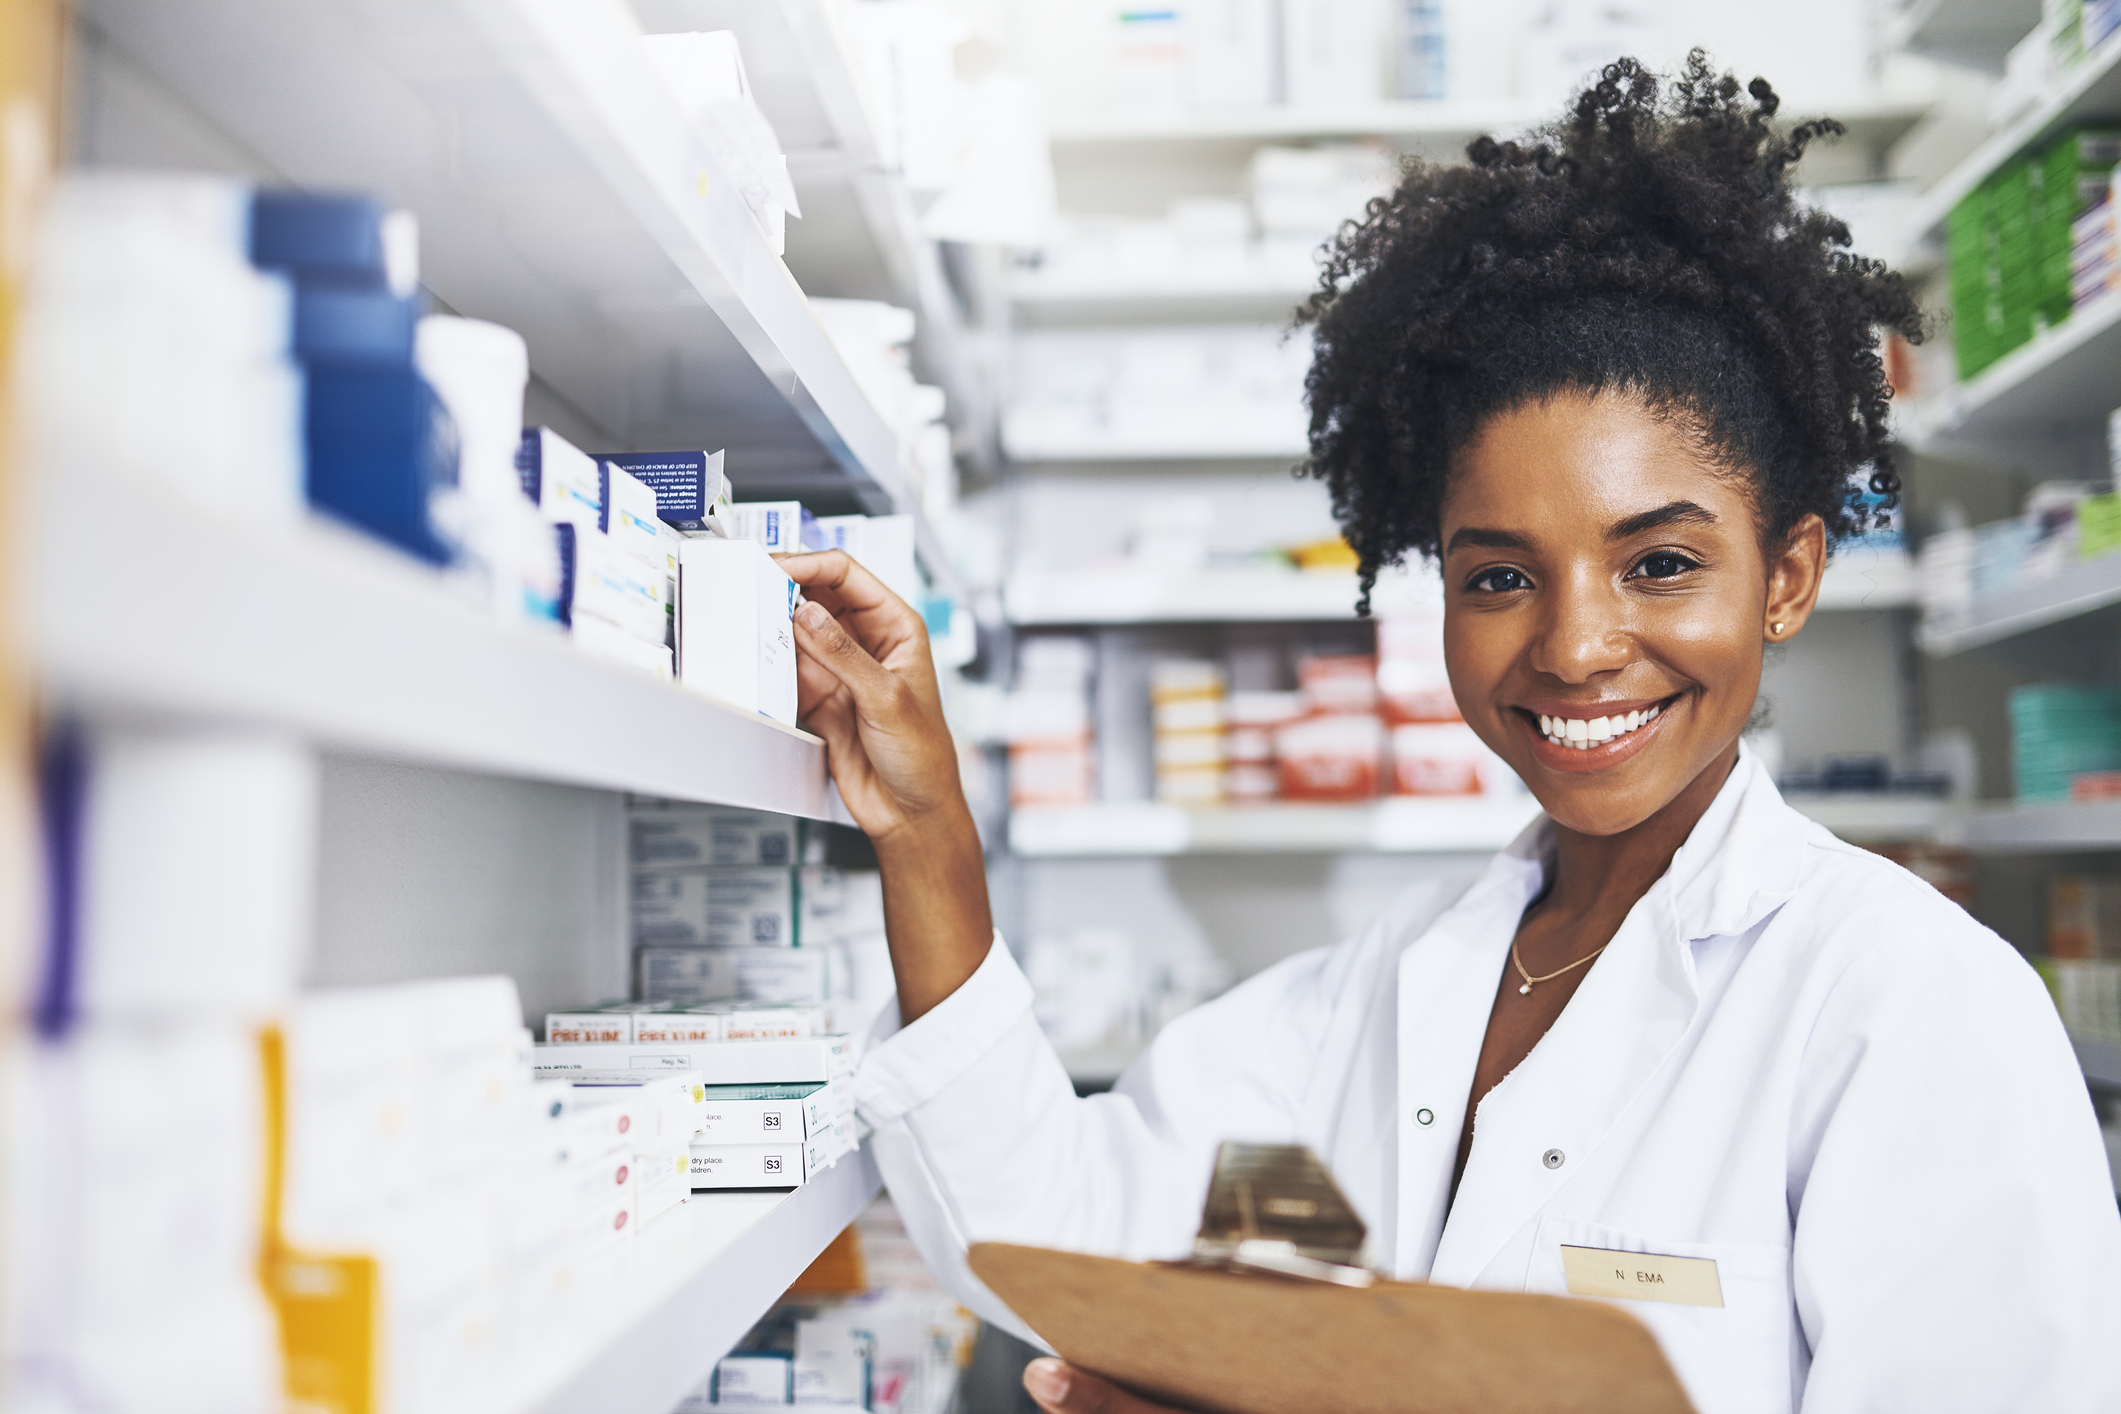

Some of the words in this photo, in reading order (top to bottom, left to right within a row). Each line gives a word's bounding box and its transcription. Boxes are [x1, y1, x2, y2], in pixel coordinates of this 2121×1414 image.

[766, 1116, 779, 1126] S3
[692, 1157, 702, 1166] dry
[704, 1156, 724, 1165] place.
[766, 1160, 780, 1170] S3
[1616, 1269, 1624, 1280] N
[1636, 1271, 1665, 1284] EMA
